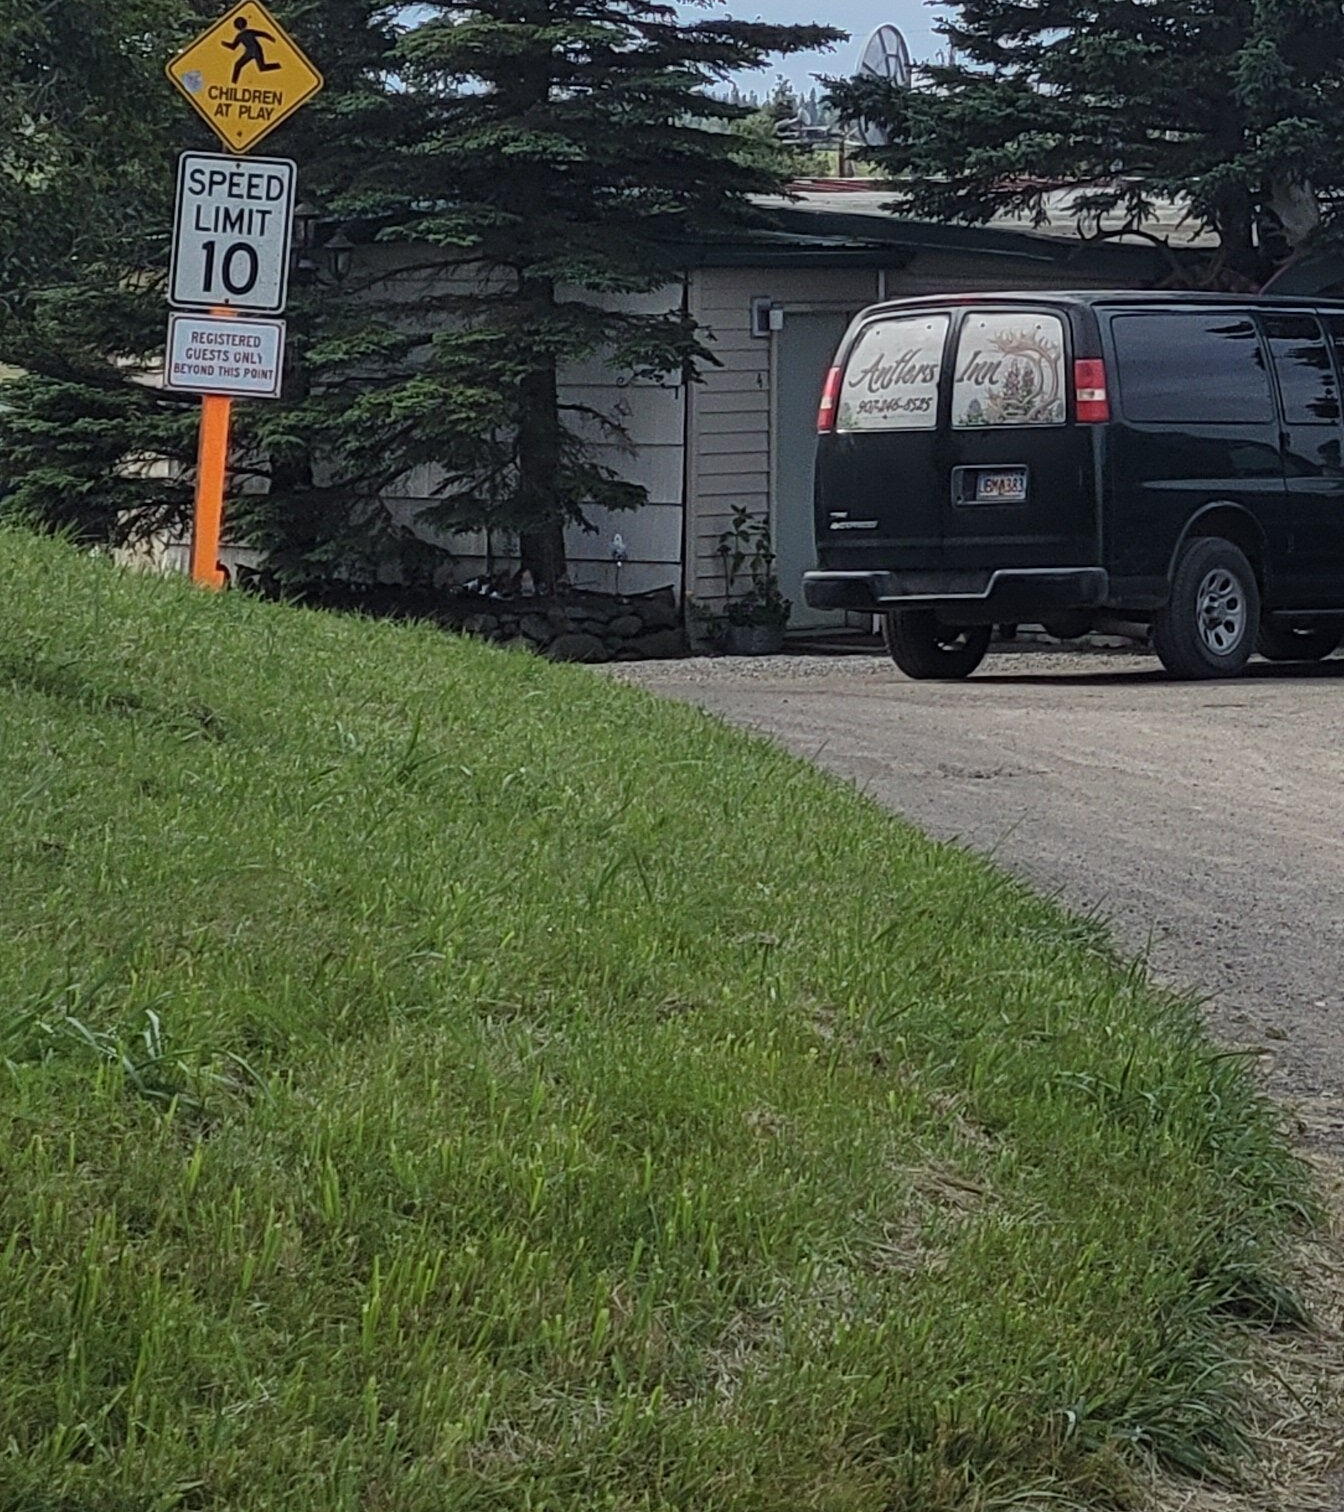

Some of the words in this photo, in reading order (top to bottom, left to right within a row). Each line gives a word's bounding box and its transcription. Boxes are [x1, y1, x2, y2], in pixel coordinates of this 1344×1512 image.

[208, 85, 283, 106] CHILDREN
[214, 103, 232, 117] AT
[238, 105, 274, 120] PLAY
[188, 168, 284, 201] SPEED
[195, 204, 272, 237] LIMIT
[202, 240, 259, 296] 10
[191, 331, 262, 348] REGISTERED
[185, 347, 229, 362] GUESTS
[233, 351, 262, 365] ONLY
[173, 362, 215, 376] BEYOND
[218, 366, 240, 378] THIS
[243, 368, 274, 380] POINT
[848, 348, 939, 393] Antlers
[955, 350, 1002, 386] Inn
